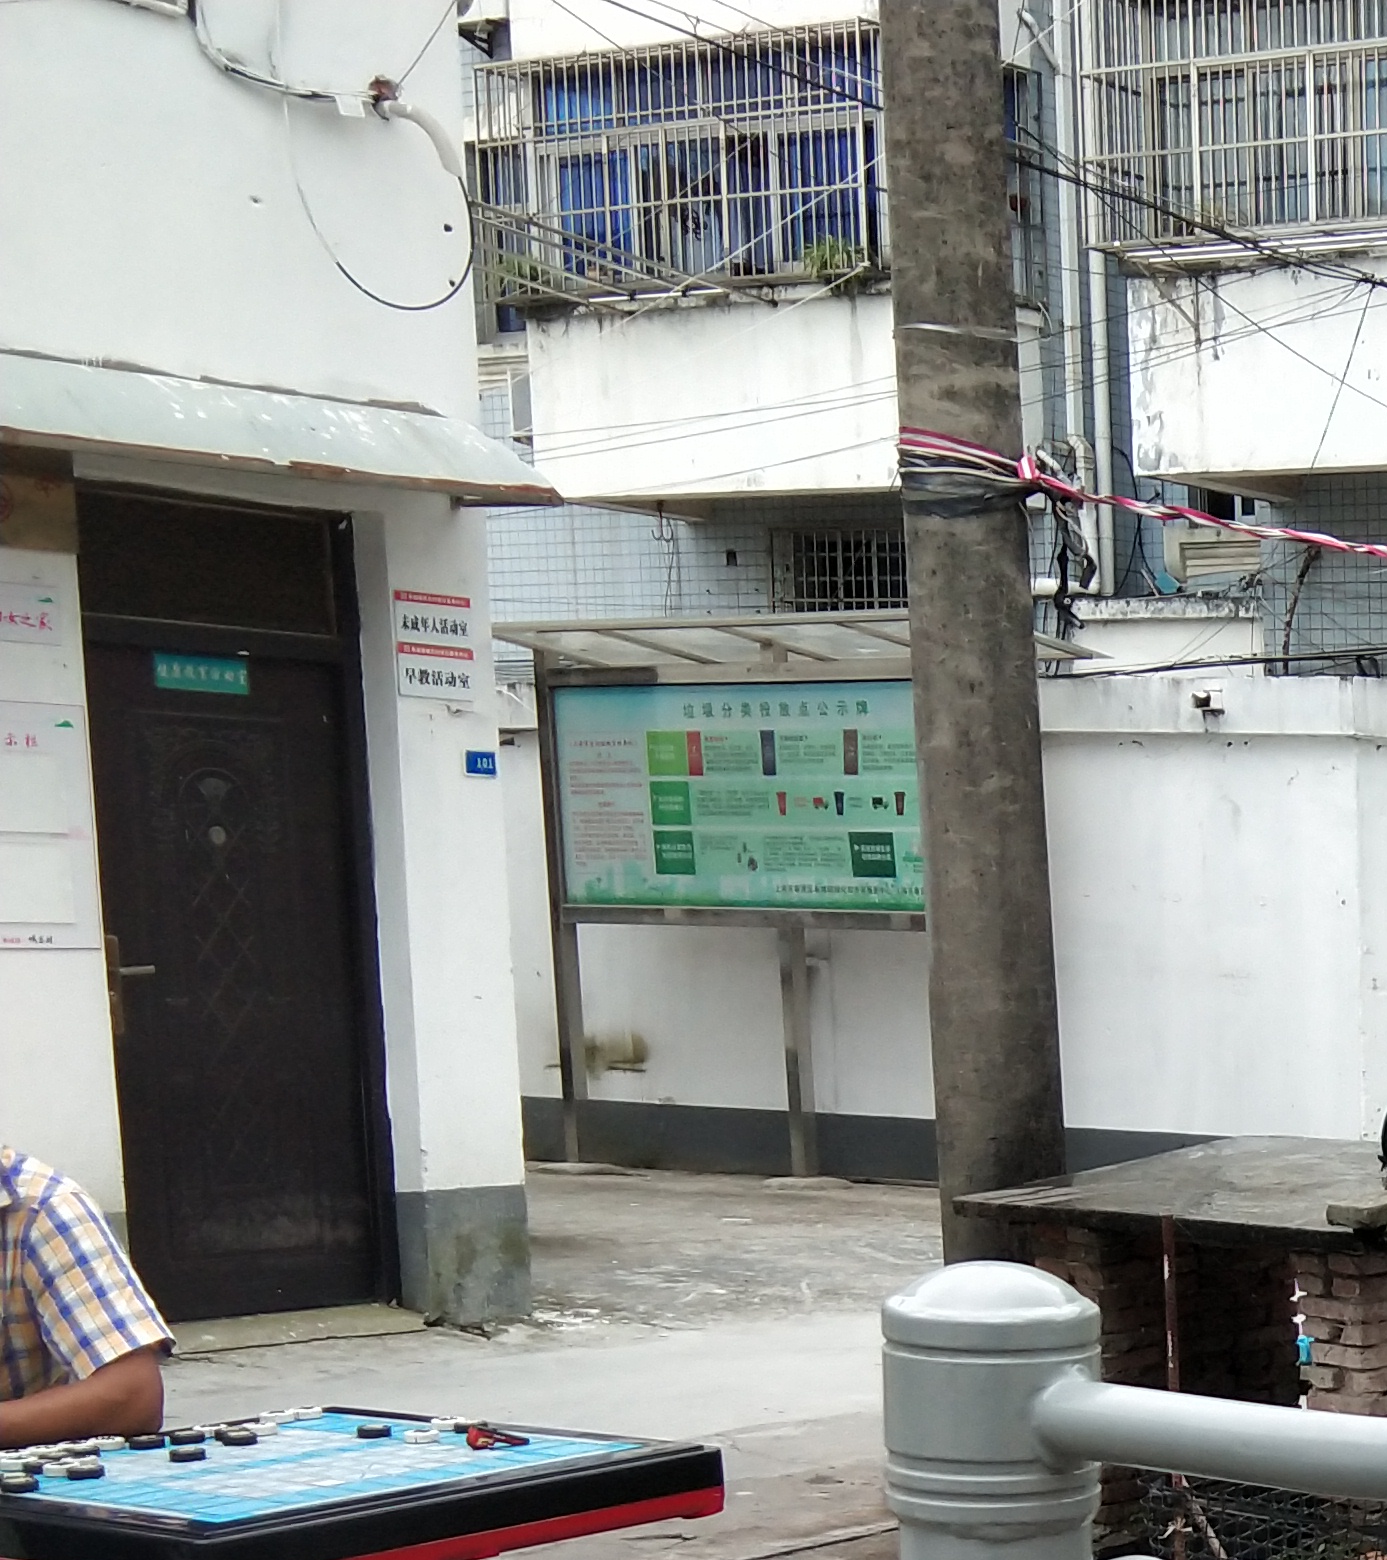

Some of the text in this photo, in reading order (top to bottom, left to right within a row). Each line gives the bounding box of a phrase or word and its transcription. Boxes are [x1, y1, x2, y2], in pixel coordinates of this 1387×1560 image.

[401, 613, 468, 637] 未成年人活动室
[405, 667, 471, 689] 早教活动室
[683, 700, 870, 718] 垃圾分类投放点公示牌
[477, 757, 494, 768] 101
